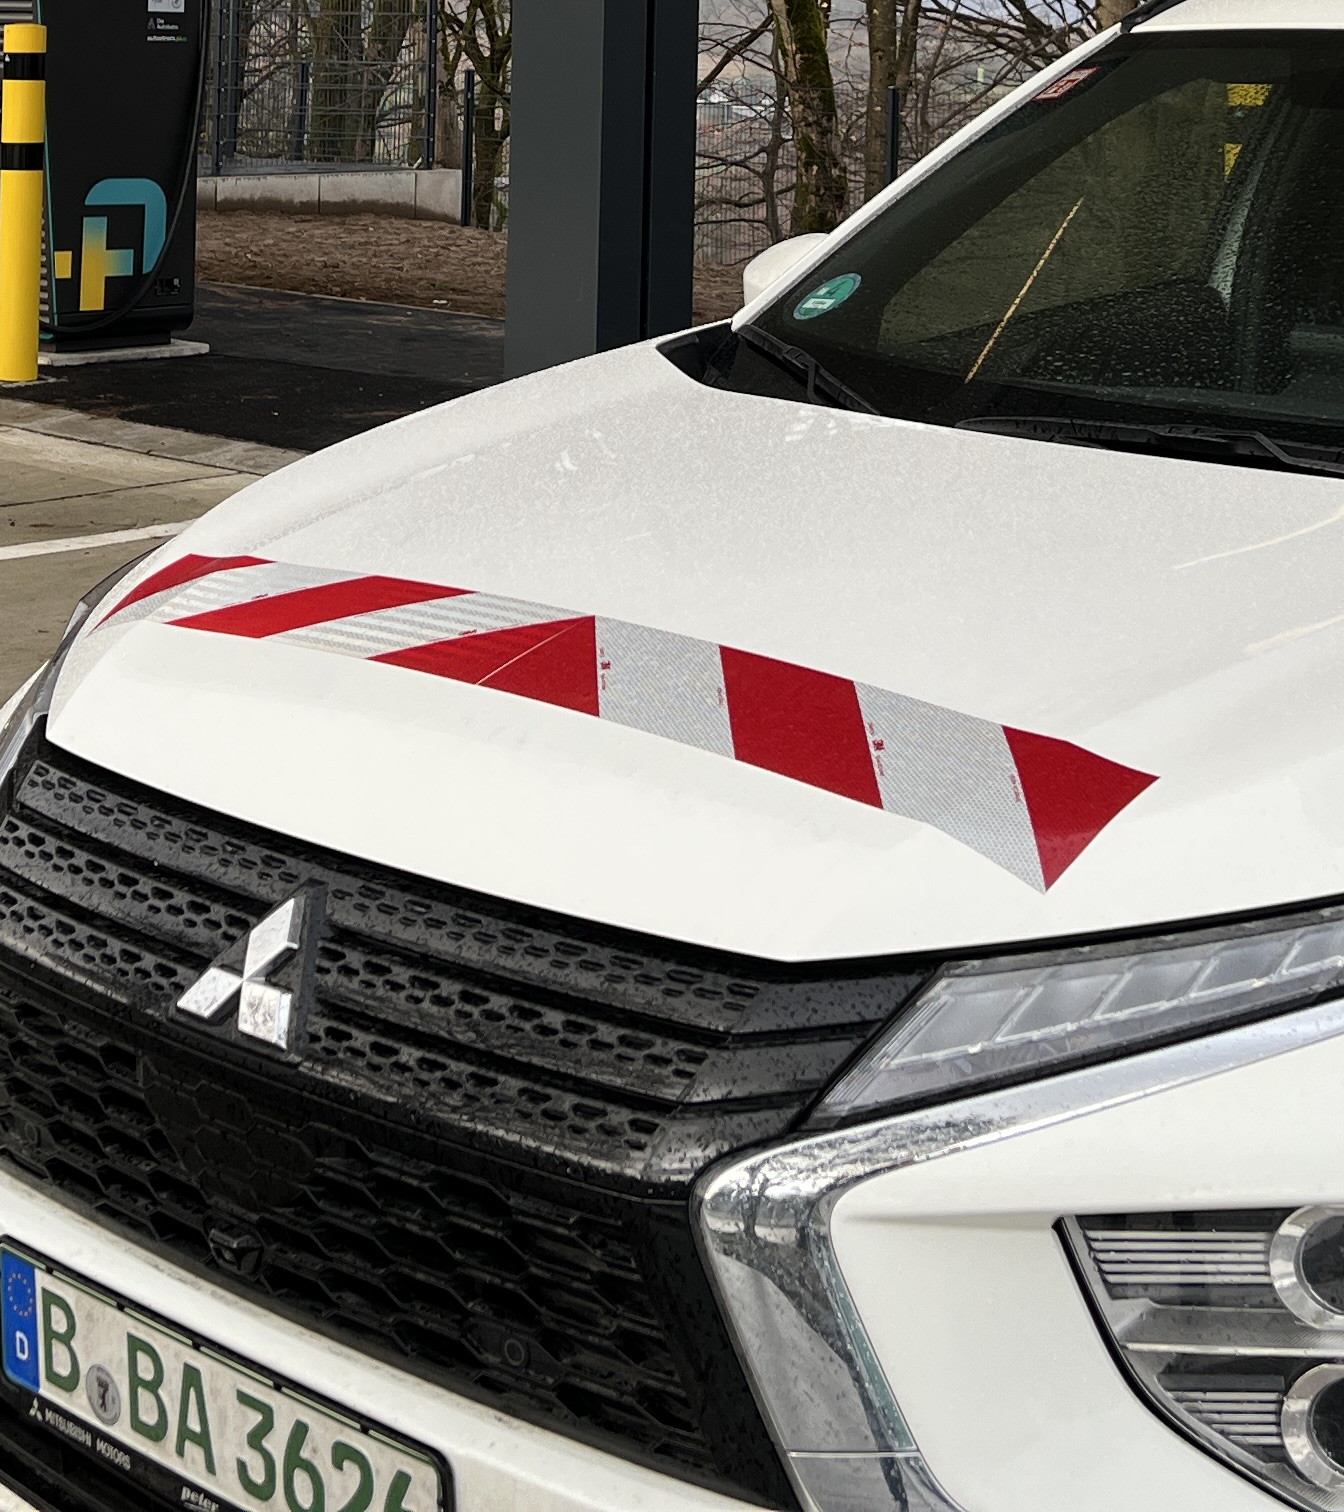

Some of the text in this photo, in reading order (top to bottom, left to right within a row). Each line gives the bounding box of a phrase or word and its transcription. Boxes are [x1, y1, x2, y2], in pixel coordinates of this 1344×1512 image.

[15, 1330, 29, 1361] D
[41, 1286, 80, 1393] B
[127, 1331, 217, 1476] BA
[44, 1407, 131, 1471] MITSUBISHI MOTORS
